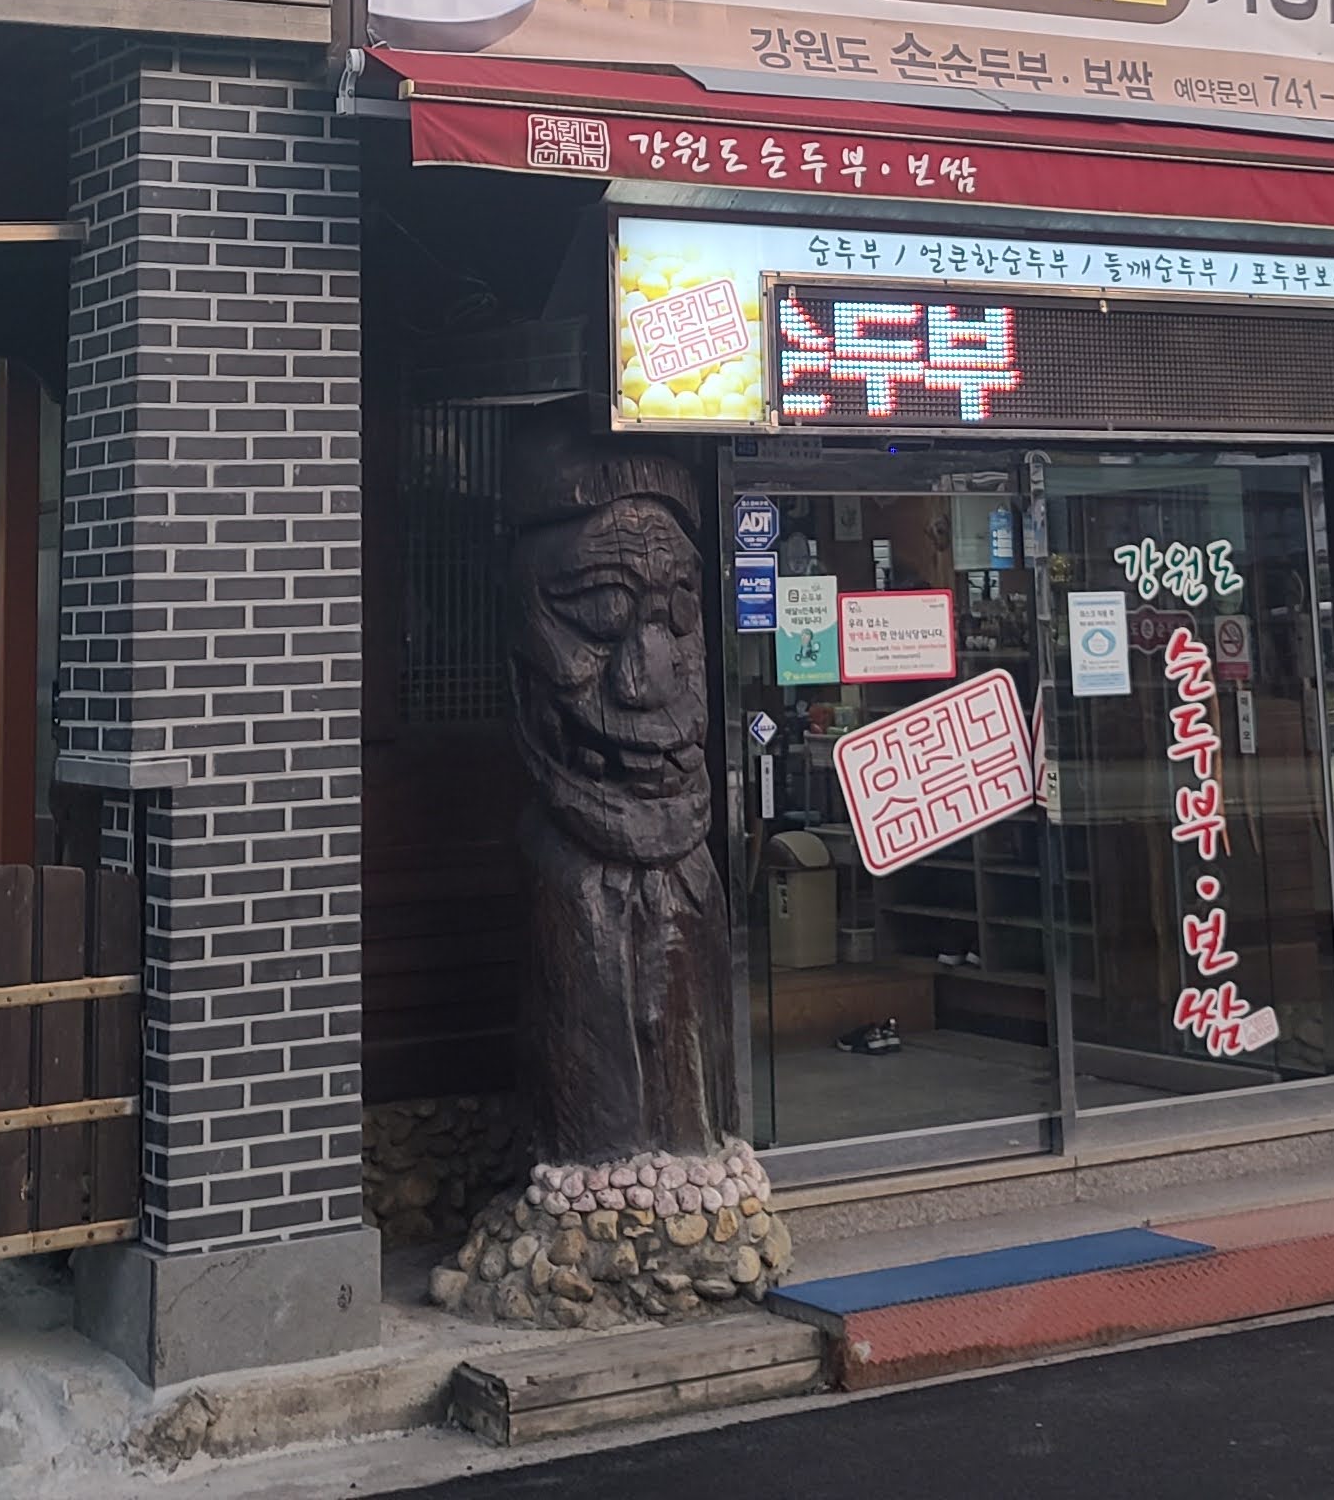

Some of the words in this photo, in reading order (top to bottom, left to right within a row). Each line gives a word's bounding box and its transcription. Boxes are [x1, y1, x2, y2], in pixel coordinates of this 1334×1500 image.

[748, 26, 878, 76] 강원도
[1082, 58, 1154, 101] 보쌈
[1172, 75, 1259, 109] 예약문의
[806, 234, 881, 271] 순두부
[919, 241, 1069, 275] 얼큰한순두부
[1103, 250, 1216, 286] 들깨순두부
[738, 511, 773, 534] ADT
[1113, 536, 1245, 607] 강원도
